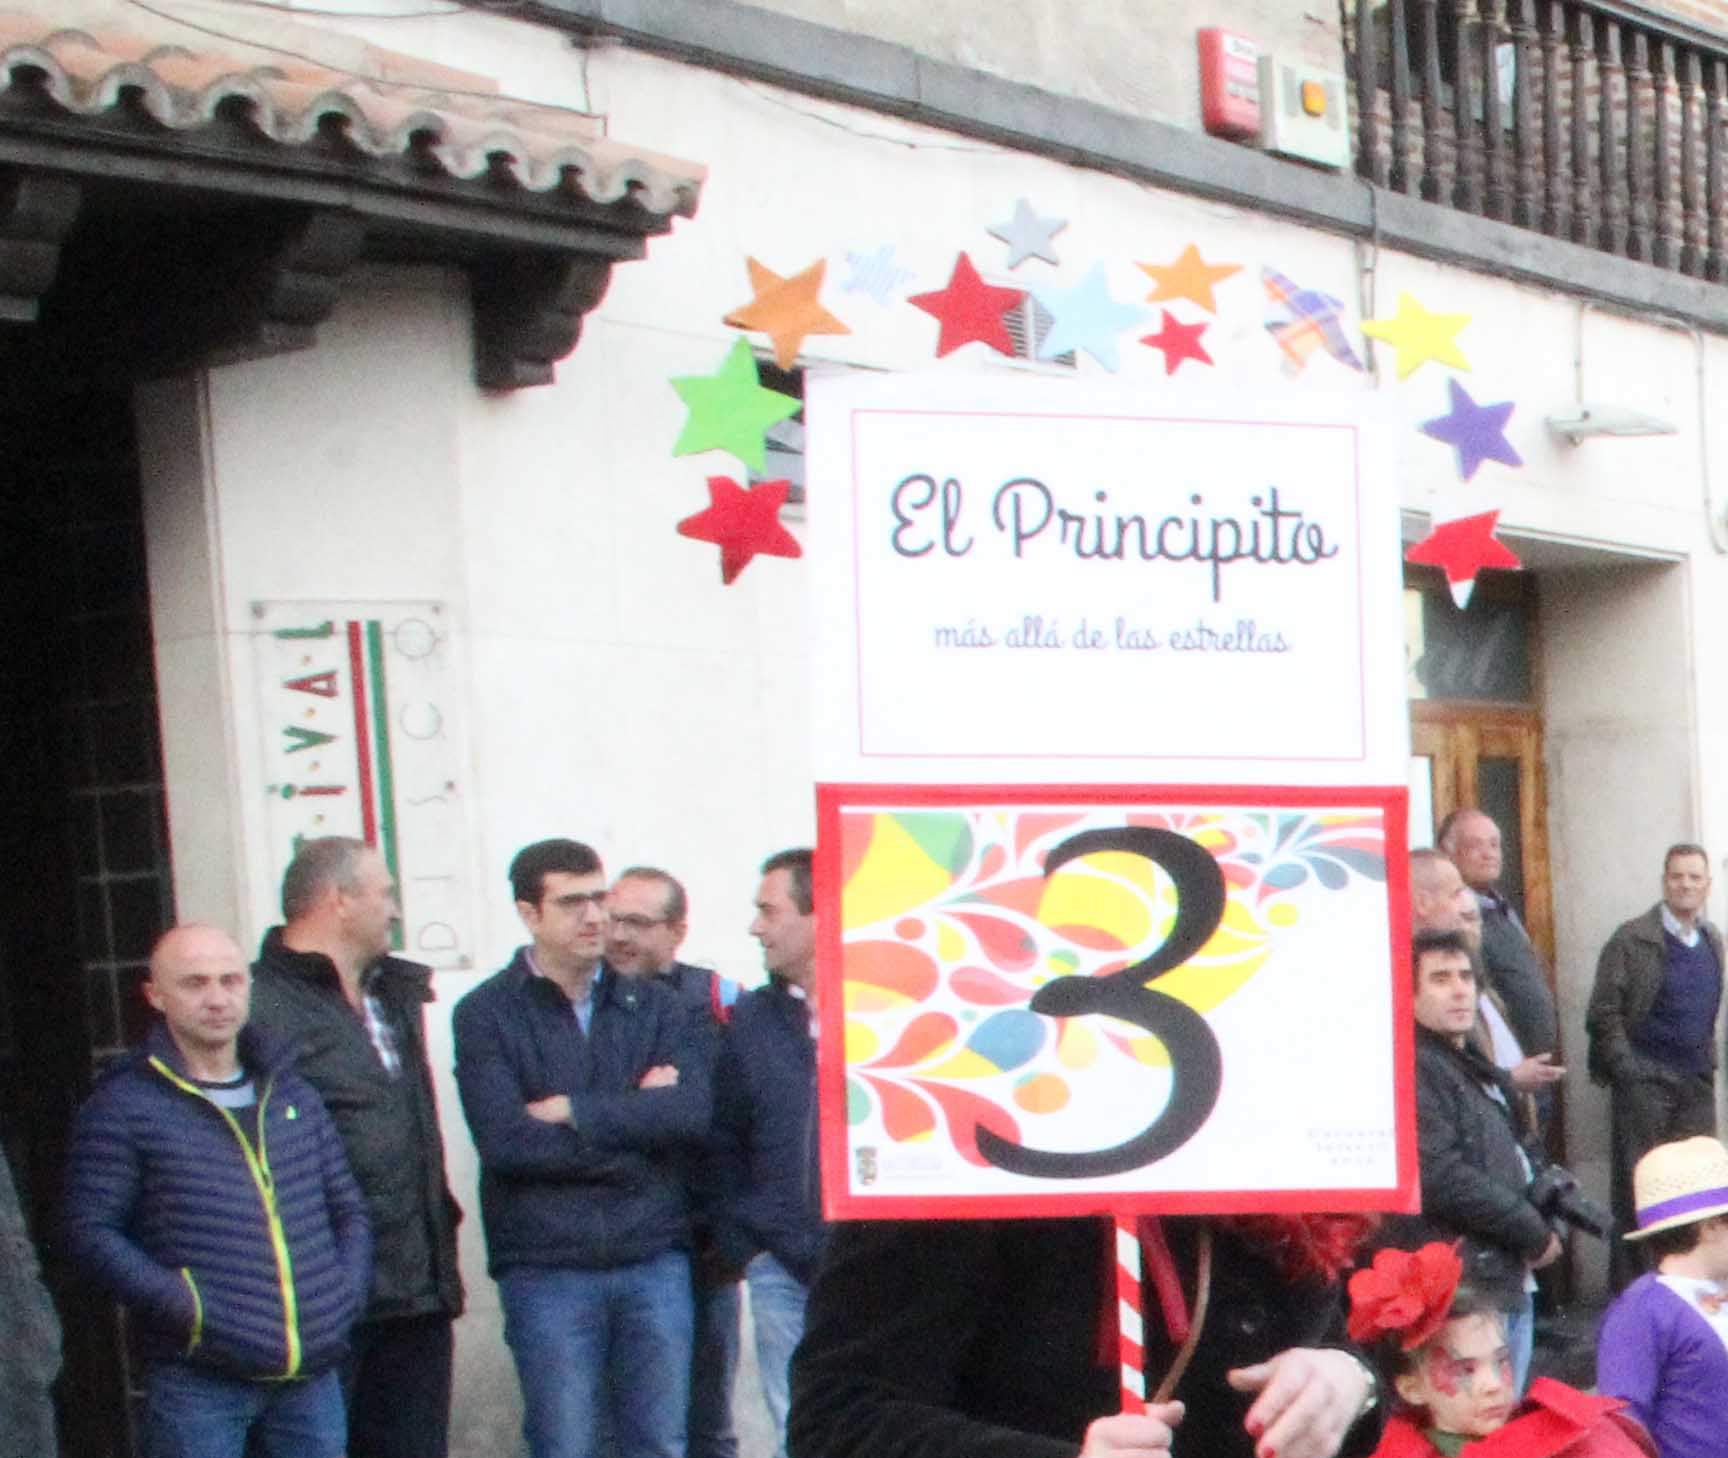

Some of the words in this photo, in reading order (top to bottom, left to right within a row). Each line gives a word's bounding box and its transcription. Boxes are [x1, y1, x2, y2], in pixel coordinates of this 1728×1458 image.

[891, 474, 974, 558] El
[992, 478, 1339, 602] Principito
[934, 618, 997, 650] más
[1004, 615, 1065, 651] allá
[1072, 617, 1105, 651] de
[1115, 615, 1161, 652] las
[1169, 616, 1291, 653] estrellas
[974, 825, 1227, 1180] 3
